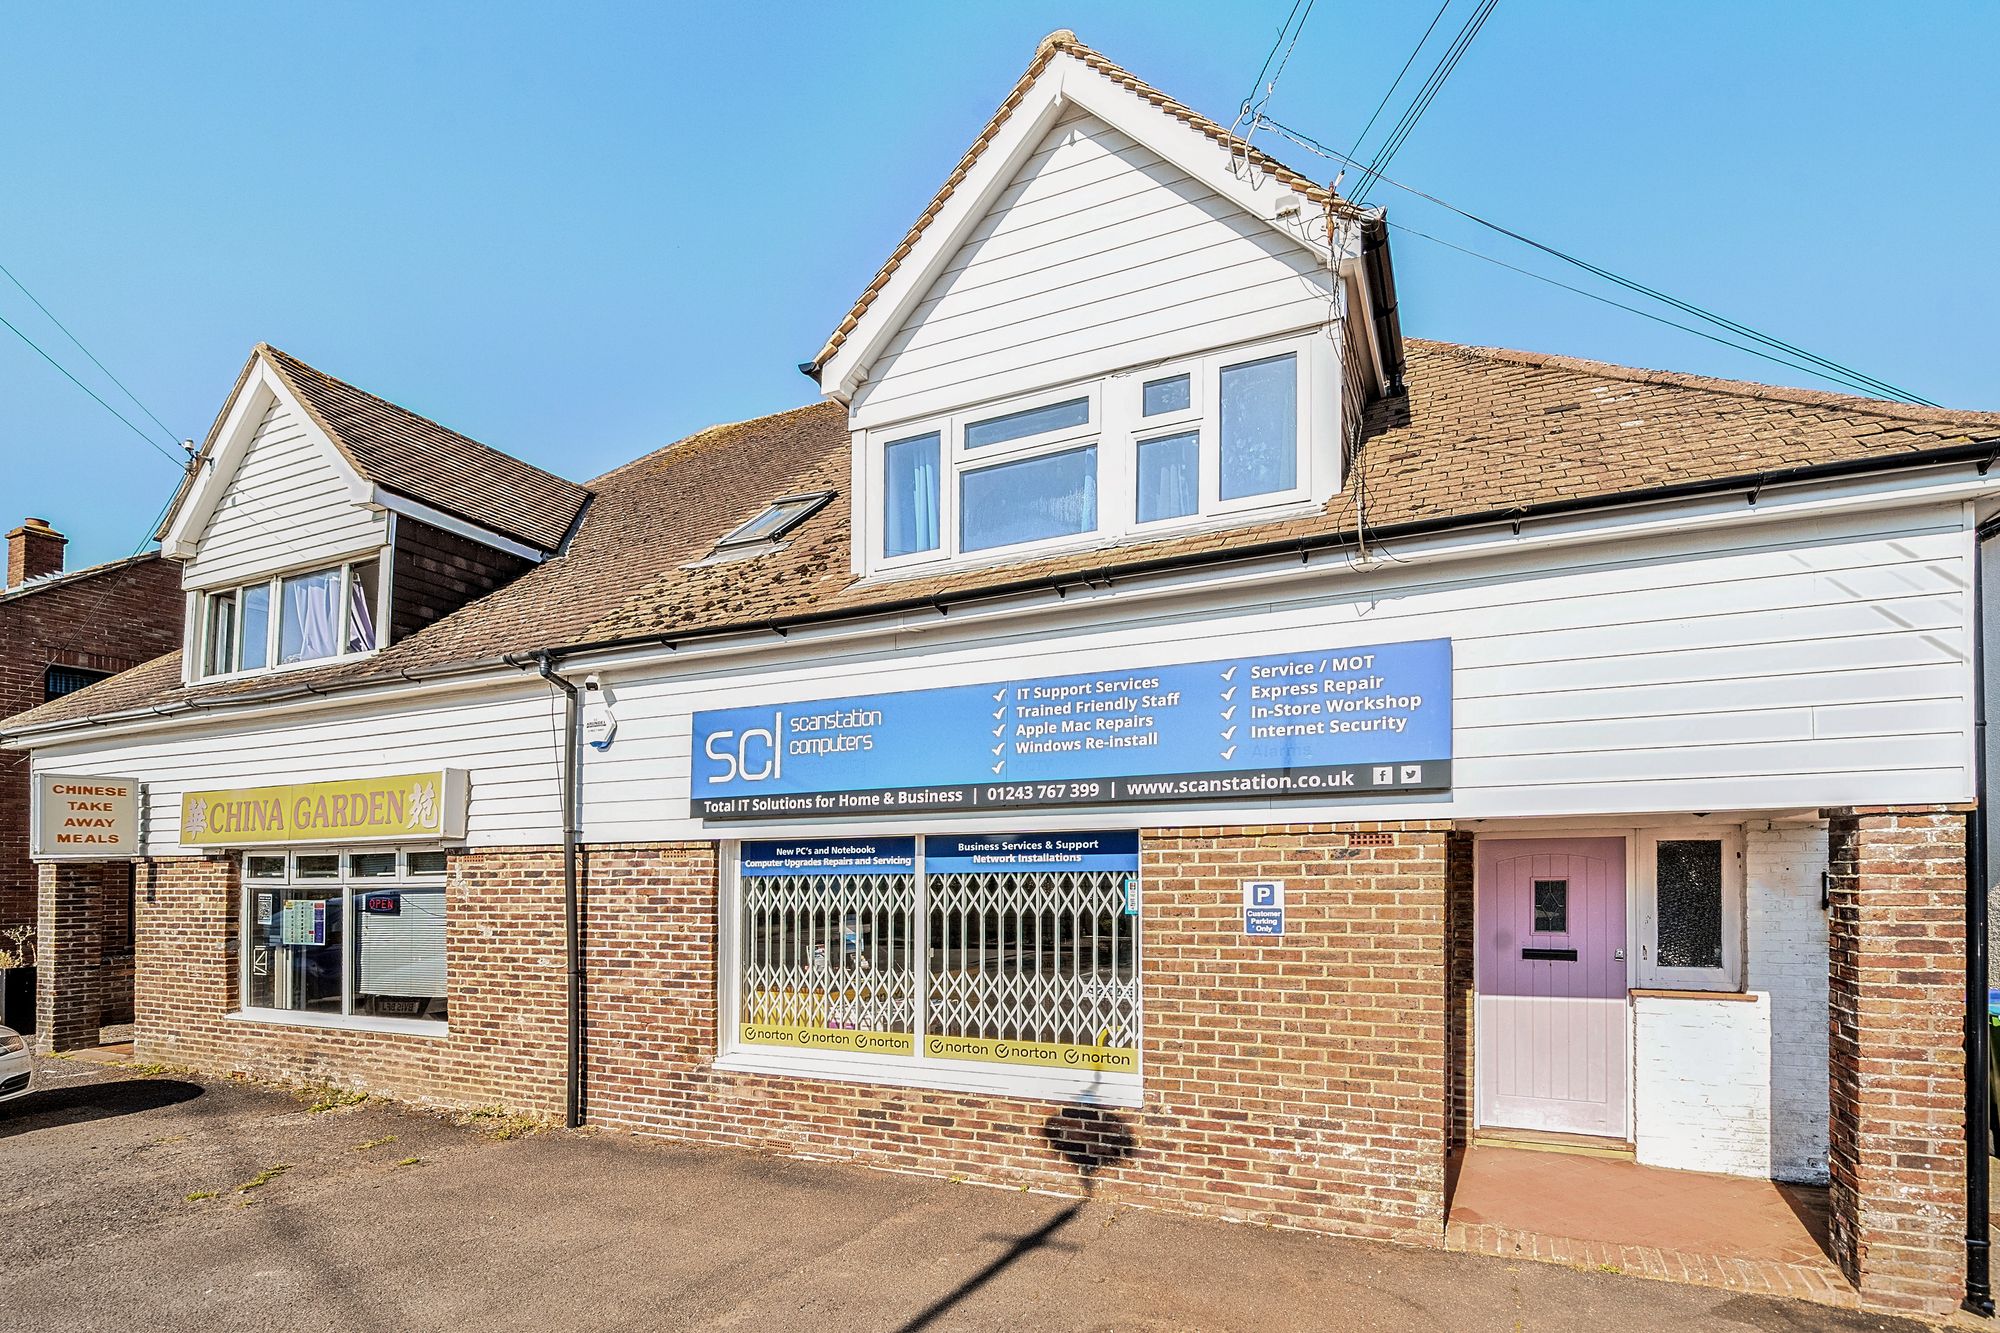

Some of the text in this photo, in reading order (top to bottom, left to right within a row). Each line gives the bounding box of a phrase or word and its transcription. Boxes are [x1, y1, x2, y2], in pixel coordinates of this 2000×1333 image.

[1251, 662, 1314, 679] Service
[1332, 655, 1375, 672] MOT
[1017, 677, 1159, 700] IT Support Services
[1251, 675, 1384, 700] Express Repair
[1017, 692, 1180, 718] Trained Friendly Staff
[1251, 694, 1422, 718] In-Store Workshop
[790, 708, 882, 733] scanstation
[1016, 715, 1153, 738] Apple Mac Repairs
[1251, 715, 1407, 738] Internet Security
[790, 733, 873, 757] computers
[1016, 732, 1158, 753] Windows Re-install
[52, 785, 127, 797] CHINESE
[704, 800, 735, 813] Total
[738, 799, 750, 811] IT
[752, 797, 812, 811] Solutions
[815, 795, 835, 808] for
[838, 794, 880, 807] Home
[883, 792, 895, 805] &
[898, 789, 963, 804] Business
[987, 785, 1033, 801] 01243
[1037, 784, 1066, 799] 767
[1070, 783, 1100, 798] 399
[1127, 770, 1355, 796] www.scanstation.co.uk
[67, 801, 113, 812] TAKE
[209, 789, 406, 834] CHINA GARDEN
[64, 818, 115, 828] AWAY
[57, 834, 119, 843] MEALS
[776, 845, 876, 856] New PC's and Notebooks
[958, 840, 1099, 852] Business Services & Support
[745, 856, 912, 868] Computer Upgrades Repairs and Servicing
[973, 853, 1082, 864] Network Installations
[1257, 887, 1271, 903] P
[369, 899, 393, 909] OPEN
[1251, 918, 1278, 926] Parking
[757, 1030, 793, 1041] norton
[812, 1032, 850, 1044] norton
[870, 1037, 909, 1049] norton
[945, 1042, 988, 1055] norton
[1012, 1047, 1057, 1059] norton
[1082, 1052, 1131, 1066] norton
